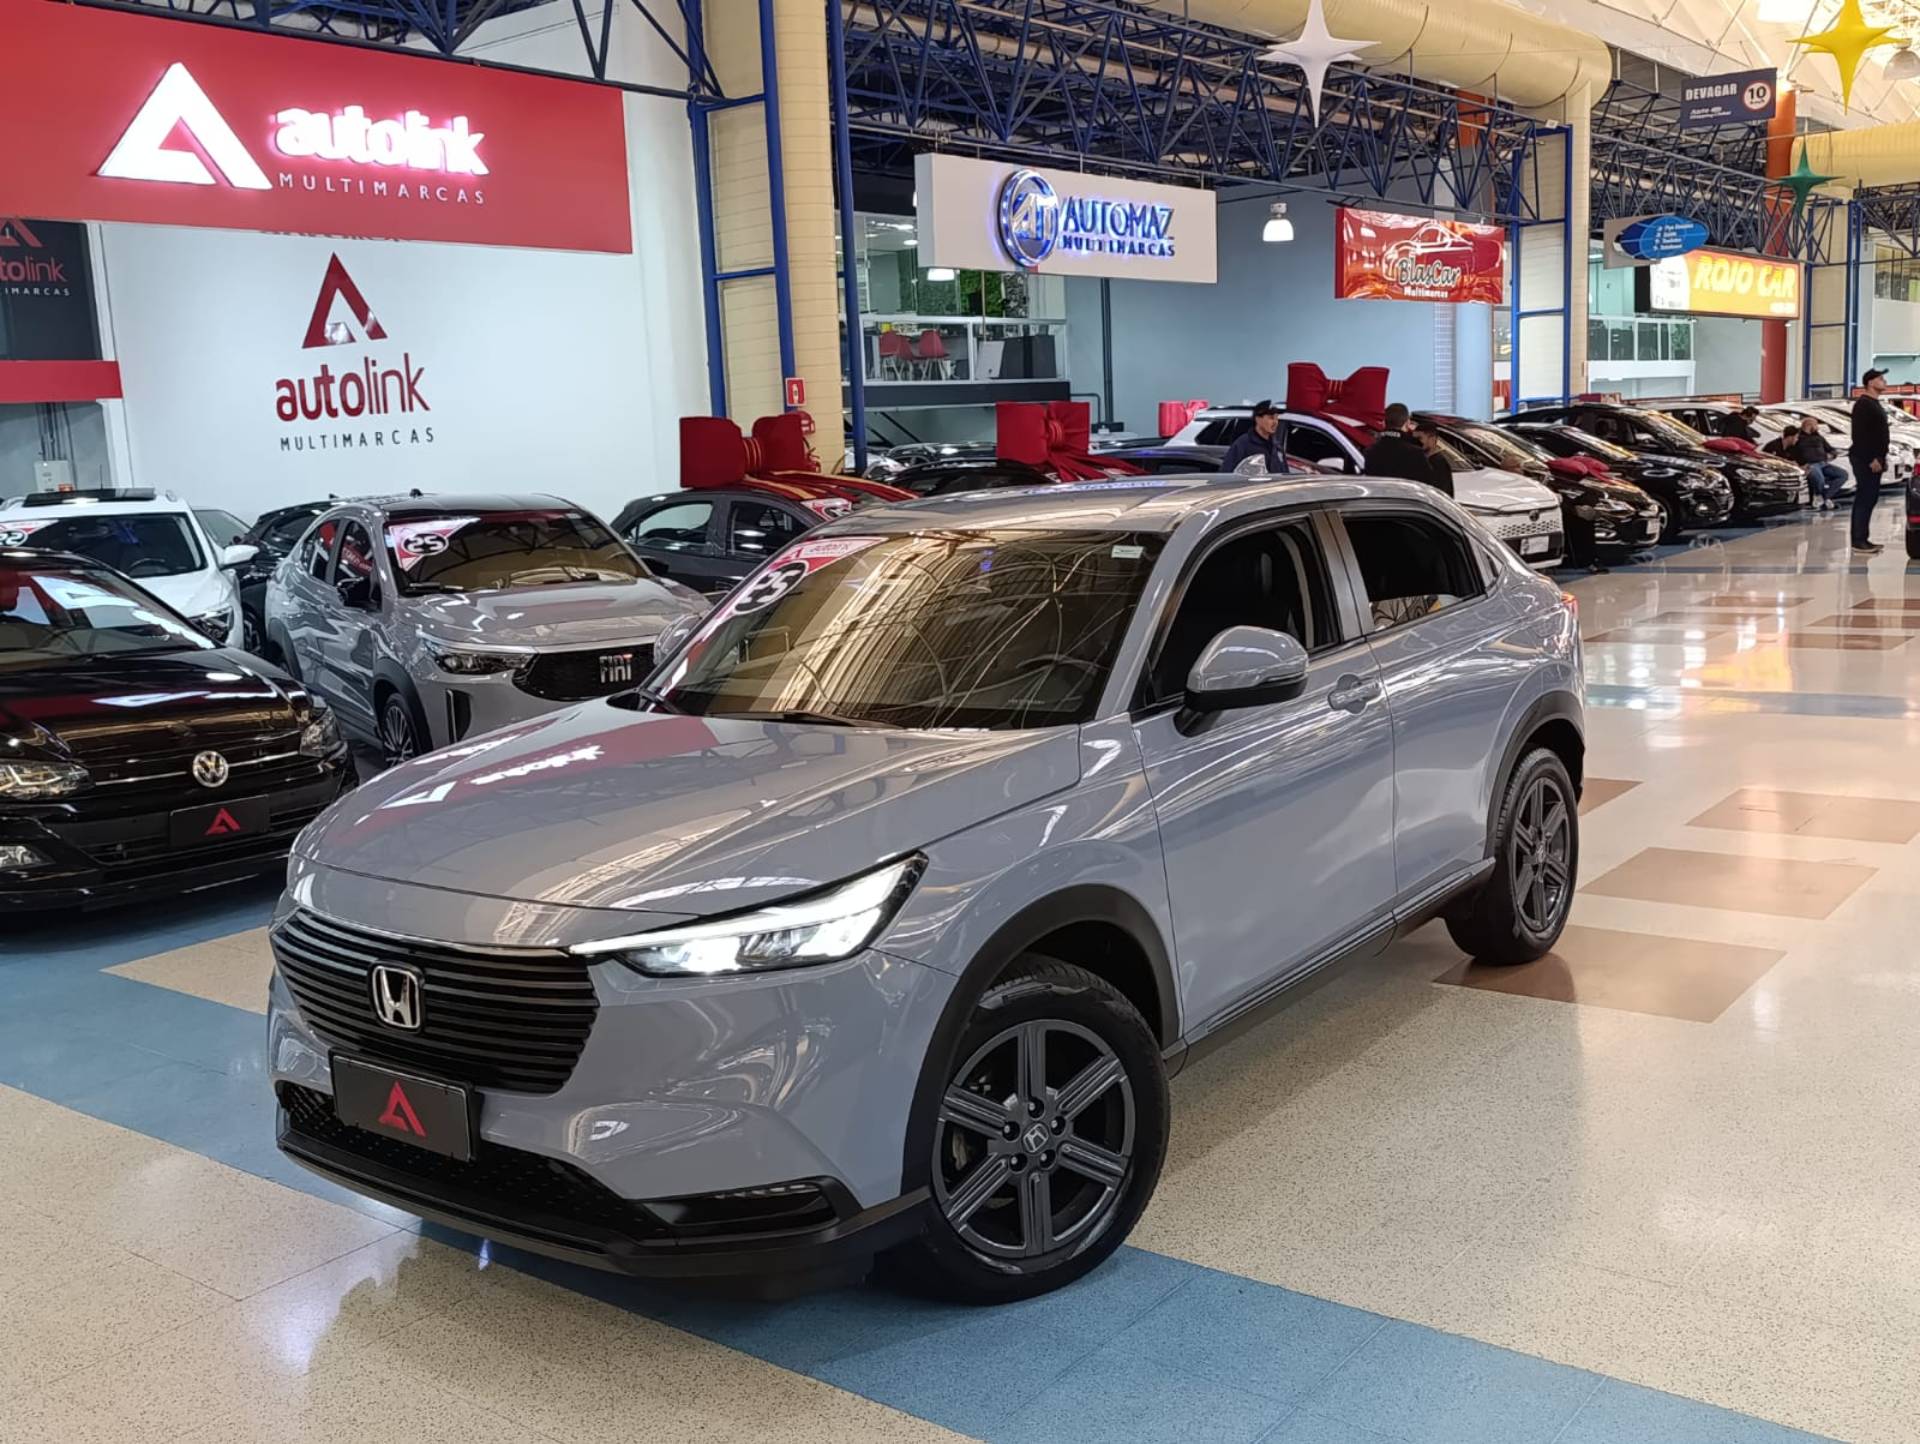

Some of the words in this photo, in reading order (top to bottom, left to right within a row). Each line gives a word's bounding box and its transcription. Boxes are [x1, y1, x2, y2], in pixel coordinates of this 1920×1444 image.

[1685, 83, 1738, 101] DEVAGAR
[1748, 86, 1767, 100] 10
[275, 105, 490, 175] autolink
[279, 172, 485, 205] MULTIMARCAS
[1061, 196, 1175, 240] AUTOMAZ
[1062, 234, 1176, 257] MULTIMARCAS
[1694, 255, 1754, 295] ROJO
[1757, 264, 1796, 298] CAR
[276, 352, 431, 422] autolink
[280, 427, 435, 451] MULTIMARCAS
[407, 535, 444, 551] 25
[739, 568, 802, 604] 25
[599, 653, 633, 684] FIAT
